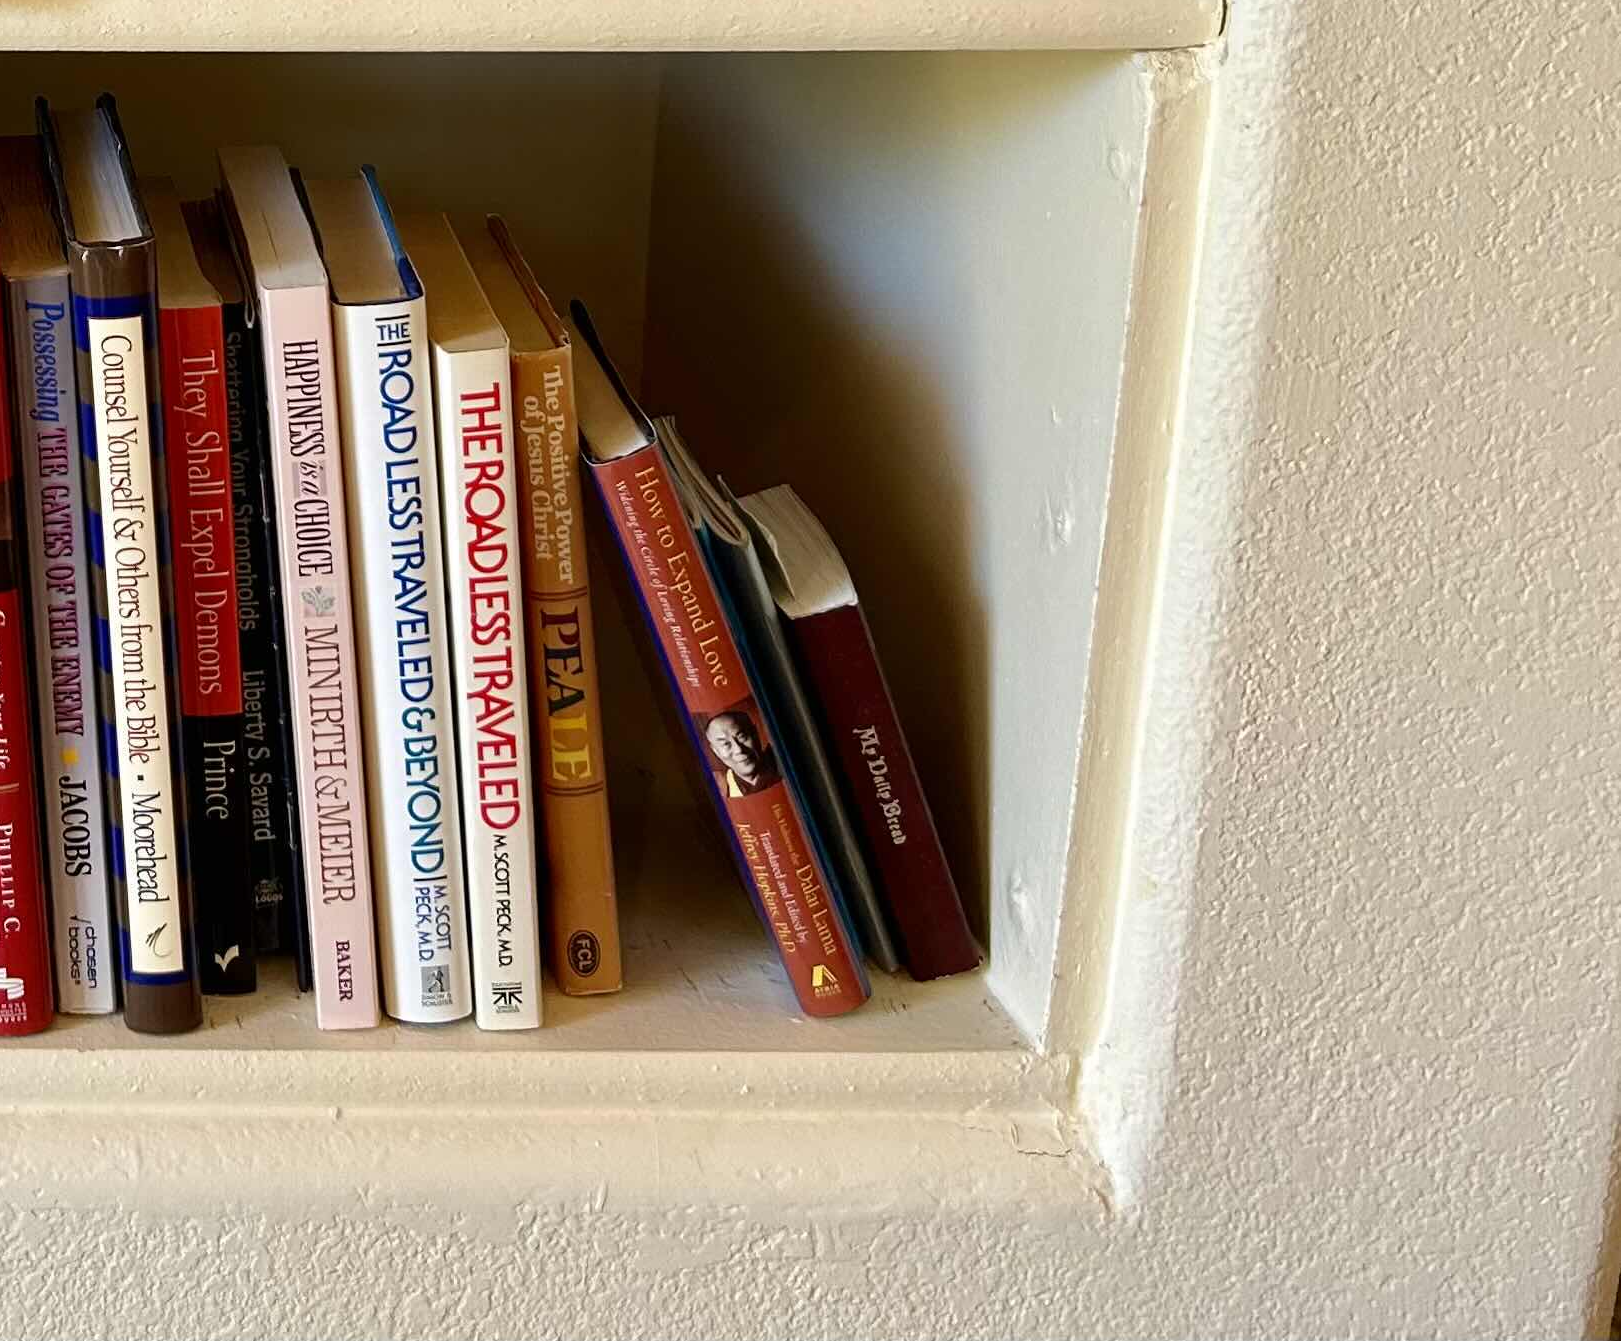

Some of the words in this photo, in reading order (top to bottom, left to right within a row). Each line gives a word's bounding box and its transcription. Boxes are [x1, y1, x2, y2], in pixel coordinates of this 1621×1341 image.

[378, 321, 410, 342] THE
[100, 334, 137, 420] Counsel
[379, 349, 417, 455] ROAD
[107, 427, 145, 513] Yourself
[386, 457, 423, 530] LESS
[114, 517, 144, 540] &
[115, 547, 146, 618] Others
[390, 531, 435, 703] TRAVELED
[634, 466, 666, 520] How
[657, 525, 675, 549] to
[667, 551, 714, 633] Expand
[699, 635, 728, 688] Love
[120, 624, 153, 675] from
[125, 679, 156, 710] the
[401, 707, 435, 732] &
[539, 608, 592, 781] PEALE
[127, 716, 160, 764] Bible
[404, 736, 444, 873] BEYOND
[852, 725, 878, 756] My
[867, 758, 890, 799] Daily
[882, 799, 907, 845] Bread
[132, 791, 170, 904] Moorehead
